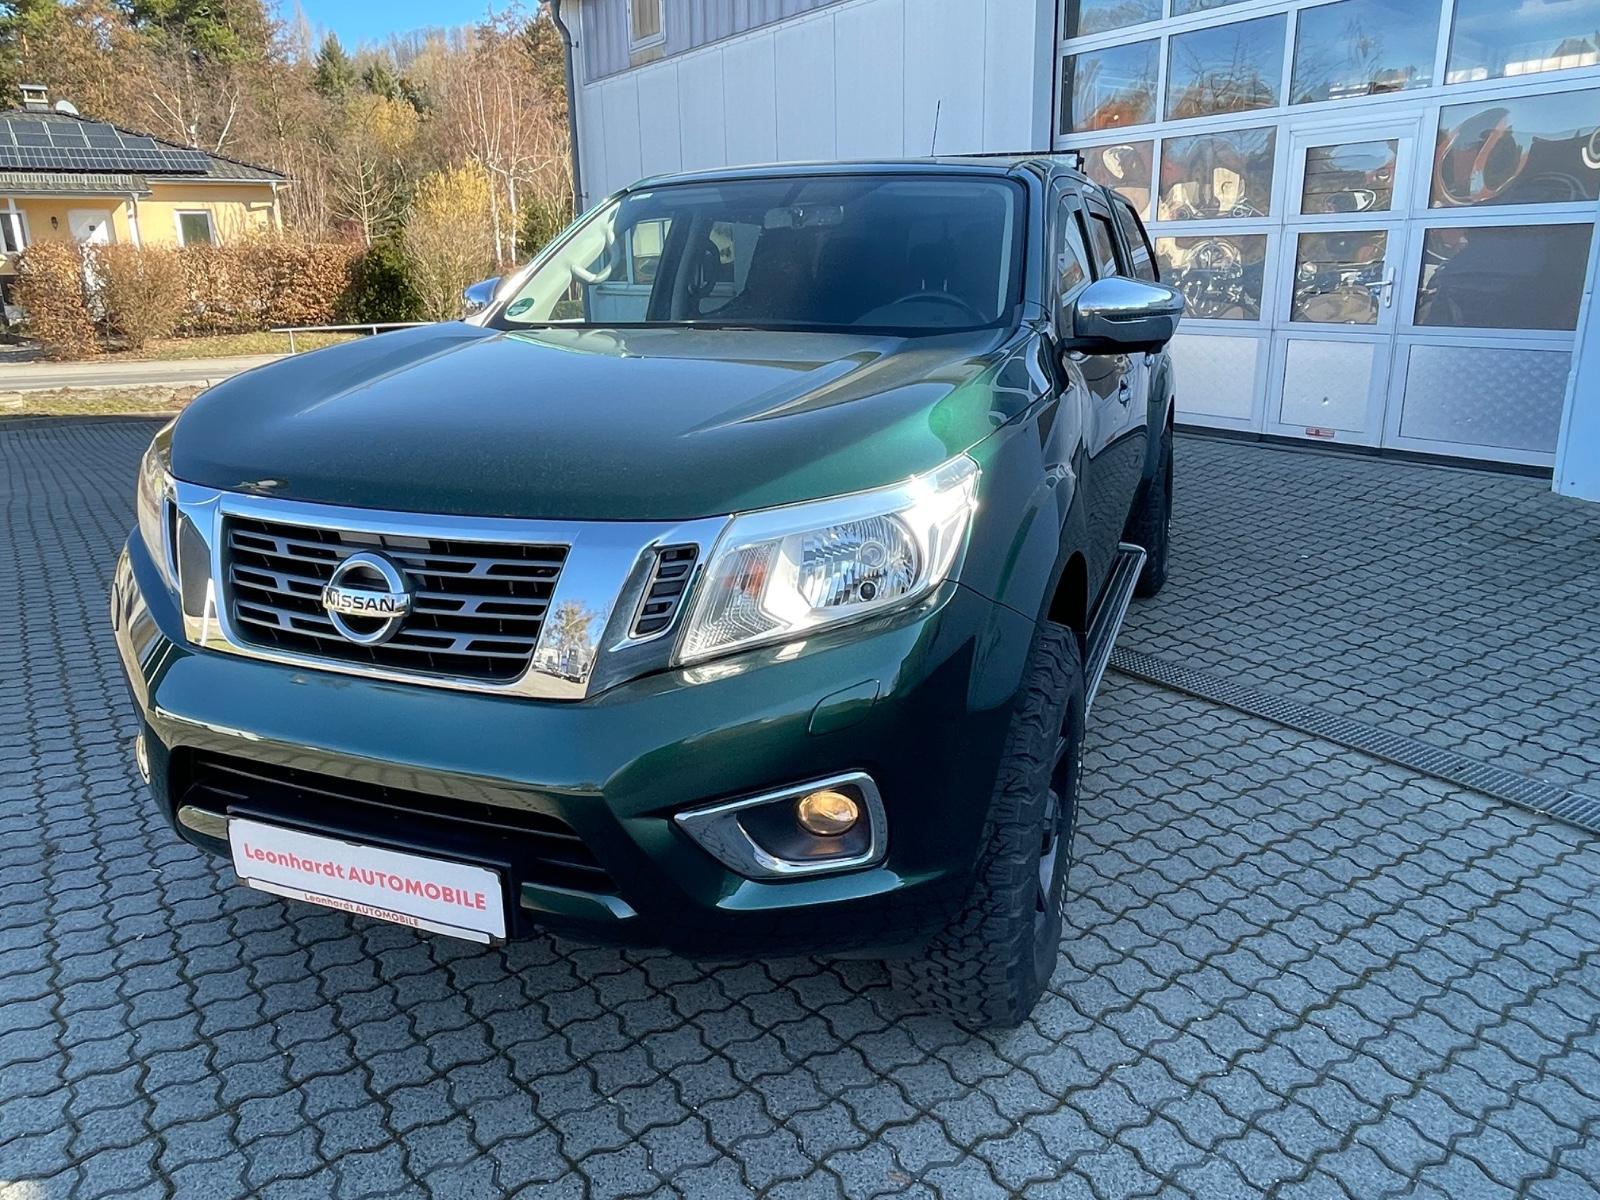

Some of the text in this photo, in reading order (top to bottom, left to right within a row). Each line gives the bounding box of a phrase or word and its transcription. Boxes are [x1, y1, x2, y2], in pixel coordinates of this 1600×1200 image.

[325, 591, 395, 612] NISSAN
[244, 843, 487, 910] Leonhardt AUTOMOBILE
[304, 893, 419, 927] Leonhardt AUTOMOBILE
